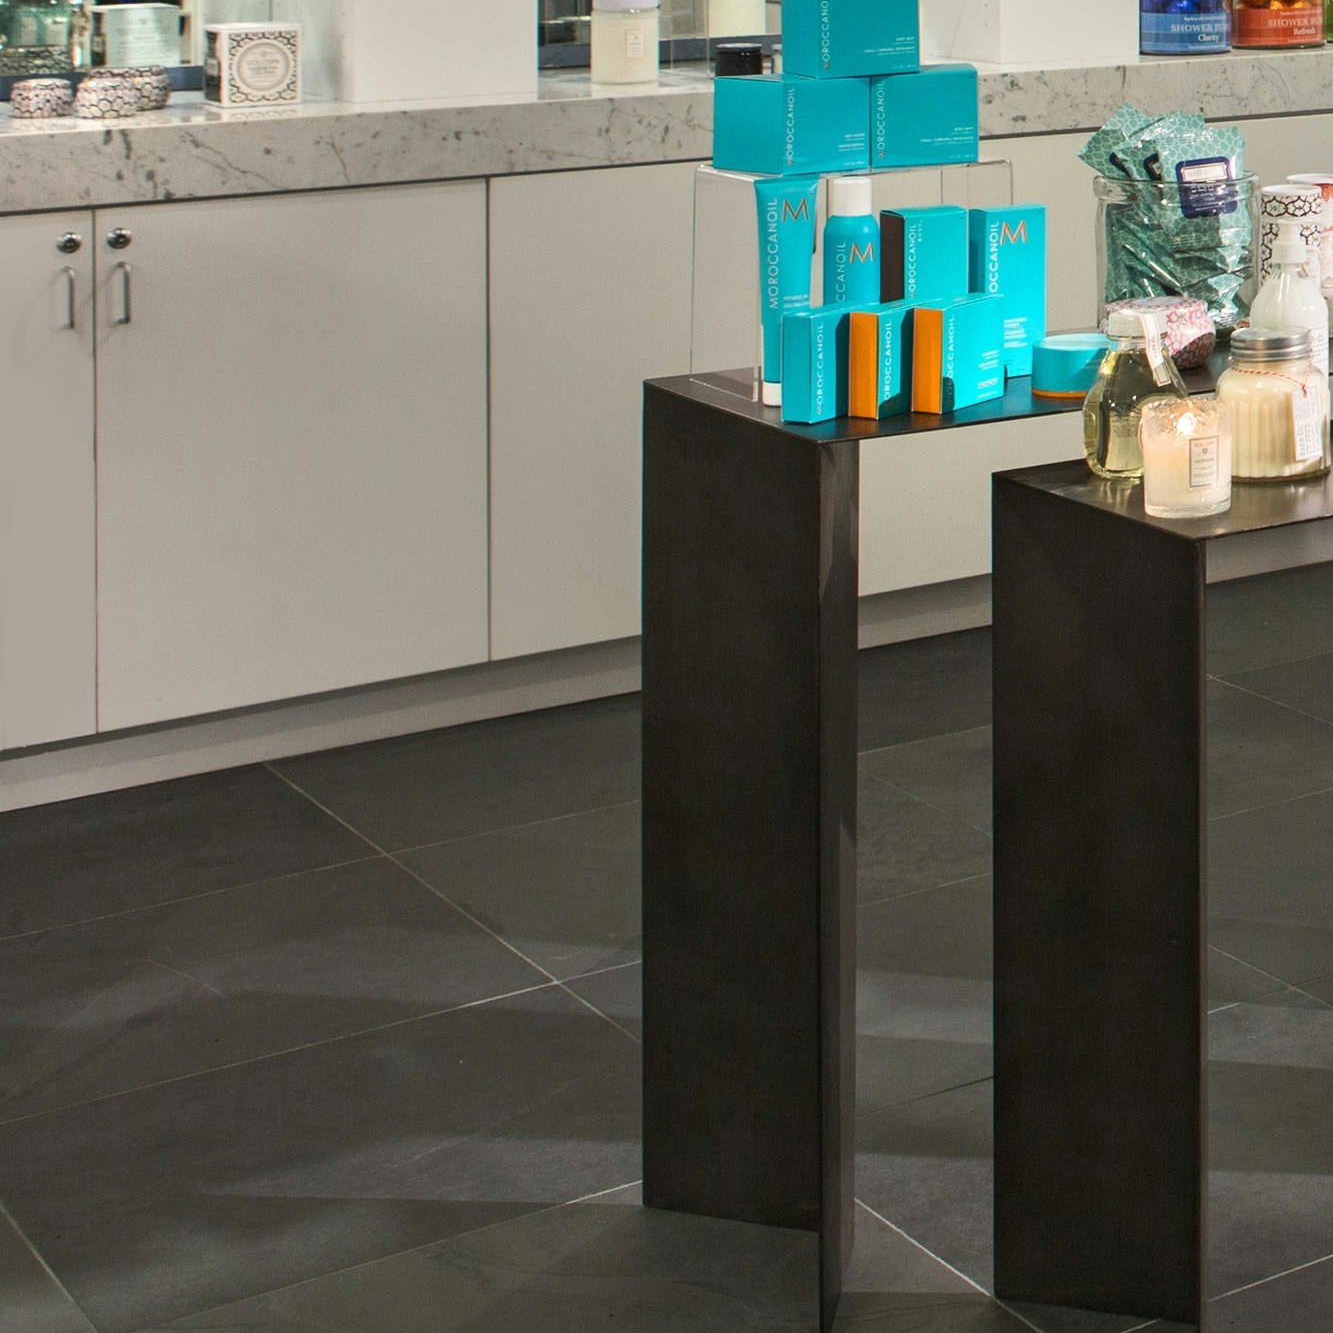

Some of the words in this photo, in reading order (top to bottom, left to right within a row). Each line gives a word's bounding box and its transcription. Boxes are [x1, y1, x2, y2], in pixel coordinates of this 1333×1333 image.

[786, 86, 796, 166] MOROCCANOIL
[875, 79, 886, 159] MOROCCANOIL
[781, 199, 809, 222] M
[1000, 220, 1028, 245] M
[767, 198, 779, 310] MOROCCANOIL
[836, 242, 846, 302] CCANOIL
[849, 242, 874, 264] M
[908, 223, 917, 299] MOROCCANOIL
[988, 220, 999, 293] OCCANOIL
[816, 323, 824, 416] MOROCCANOIL
[884, 321, 893, 402] OROCCANOIL
